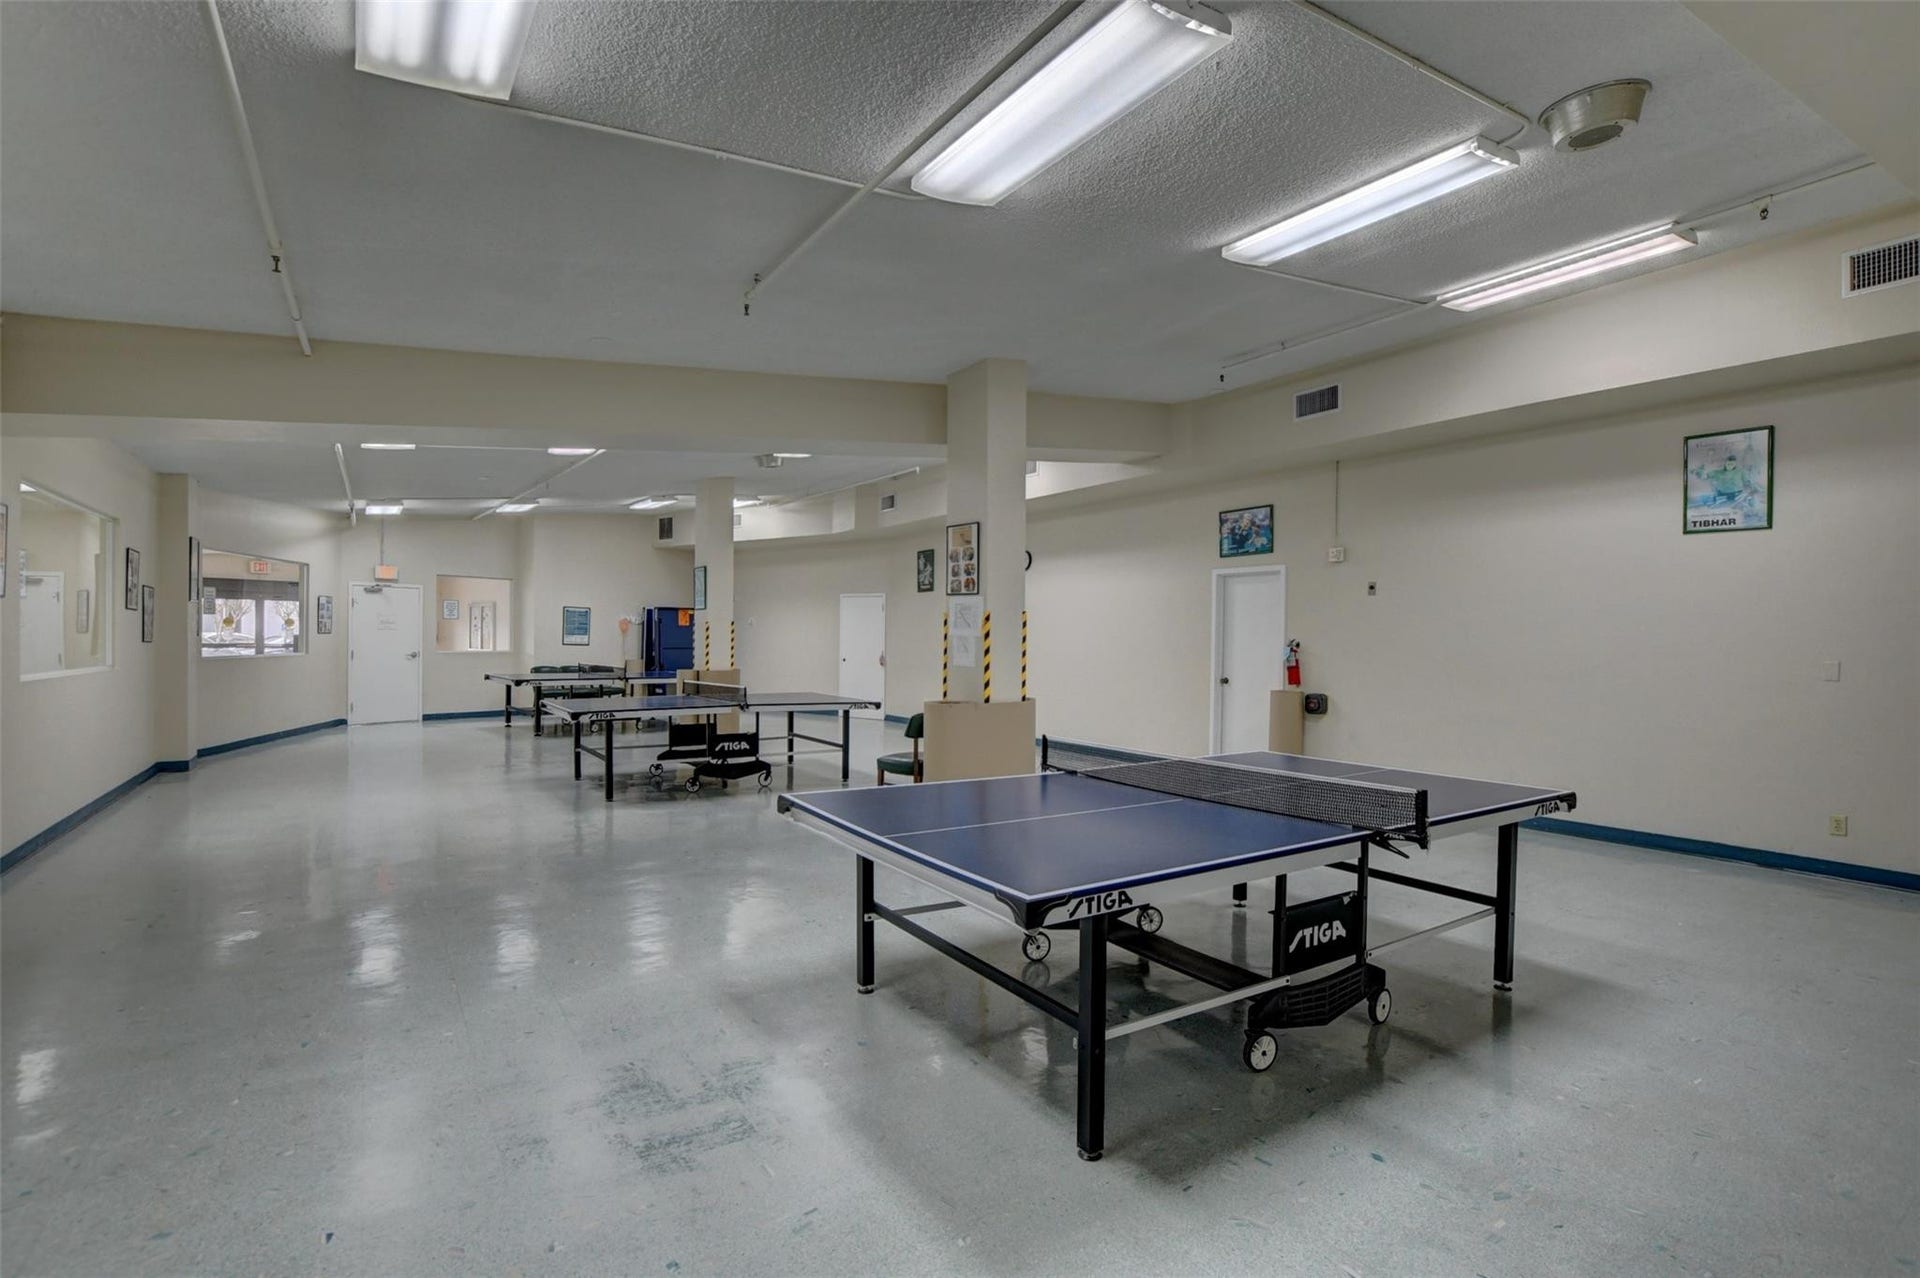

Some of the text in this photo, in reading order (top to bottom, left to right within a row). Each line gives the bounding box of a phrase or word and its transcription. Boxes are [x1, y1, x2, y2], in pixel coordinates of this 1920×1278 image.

[1691, 518, 1737, 528] TIBHAR
[588, 711, 616, 720] STIGA
[715, 741, 750, 751] STIGA
[1534, 801, 1561, 816] STIGA
[1068, 890, 1133, 919] STIGA
[1288, 920, 1347, 954] STIGA
